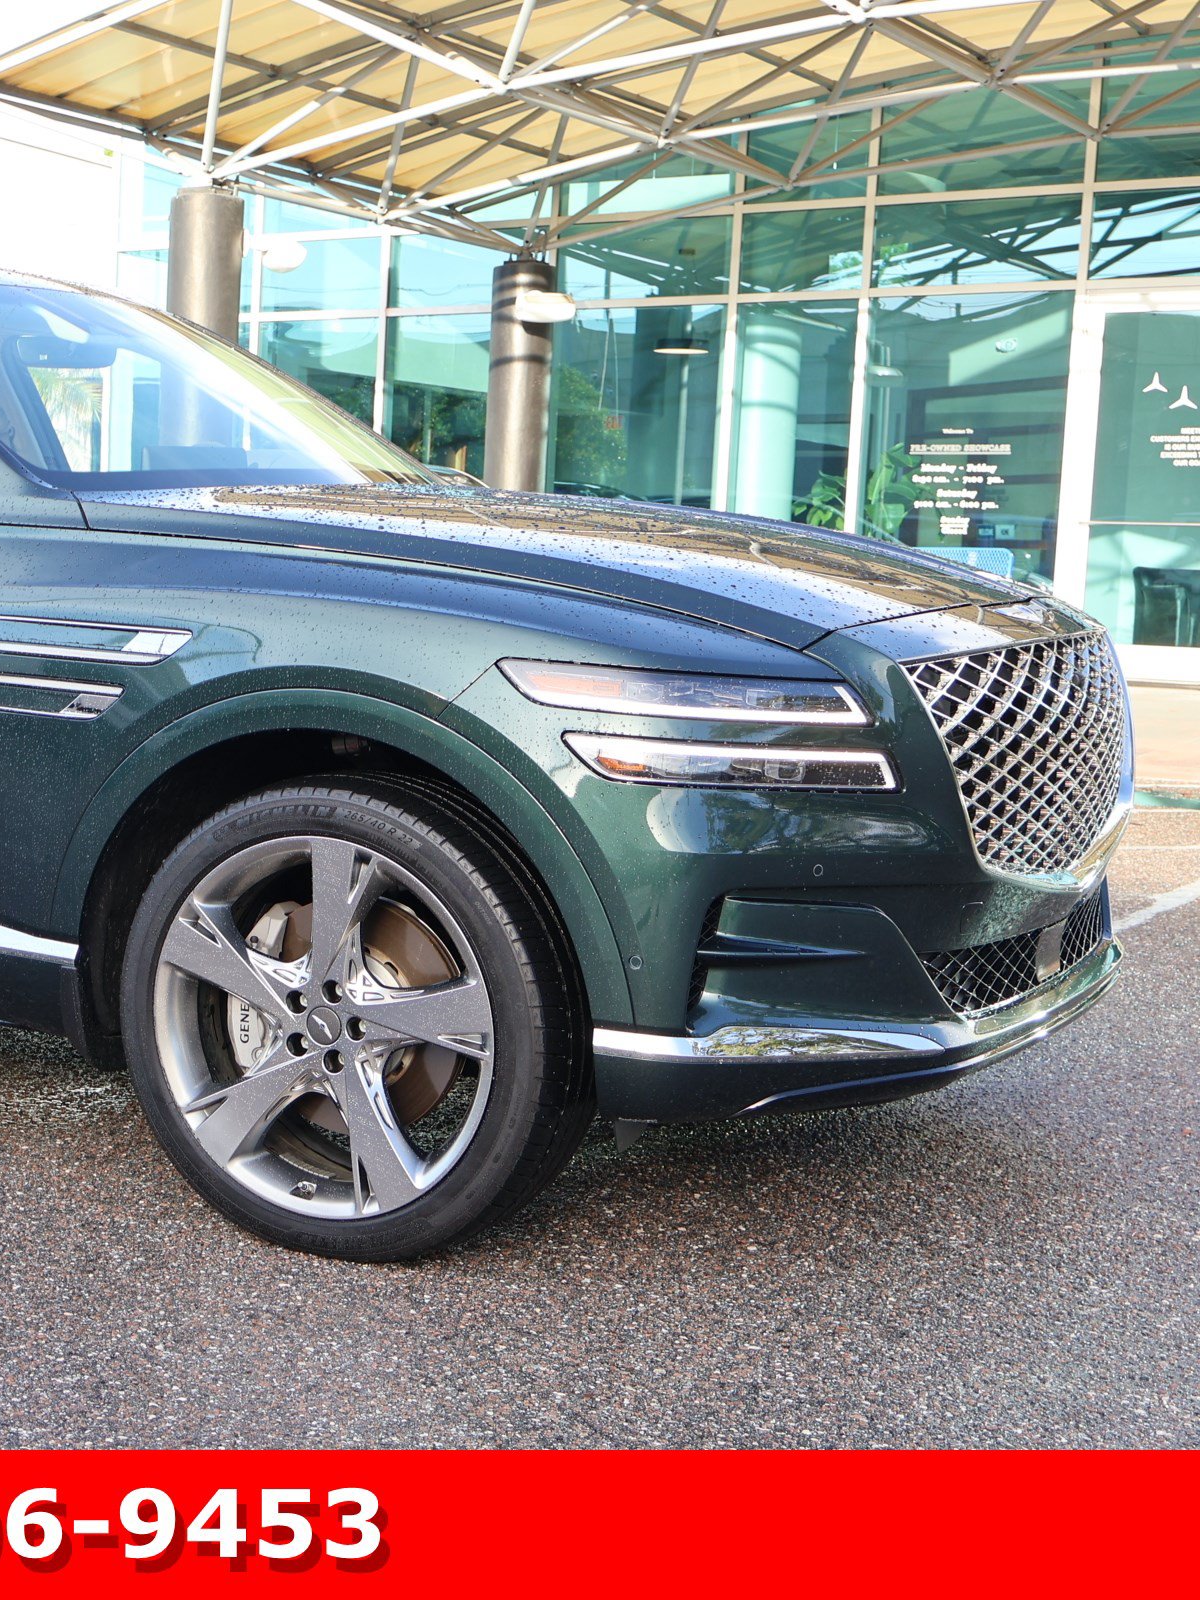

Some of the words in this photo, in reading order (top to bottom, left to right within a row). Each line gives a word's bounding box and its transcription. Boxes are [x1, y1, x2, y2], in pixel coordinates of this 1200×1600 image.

[910, 444, 962, 452] PRE-OWNED
[964, 444, 1011, 452] SHOWCASE
[921, 463, 957, 474] Monday
[966, 463, 998, 474] Friday
[936, 488, 978, 499] Saturday
[940, 516, 970, 526] Sunday
[344, 810, 386, 830] 265/40
[387, 828, 397, 836] R
[240, 1002, 250, 1044] GENE
